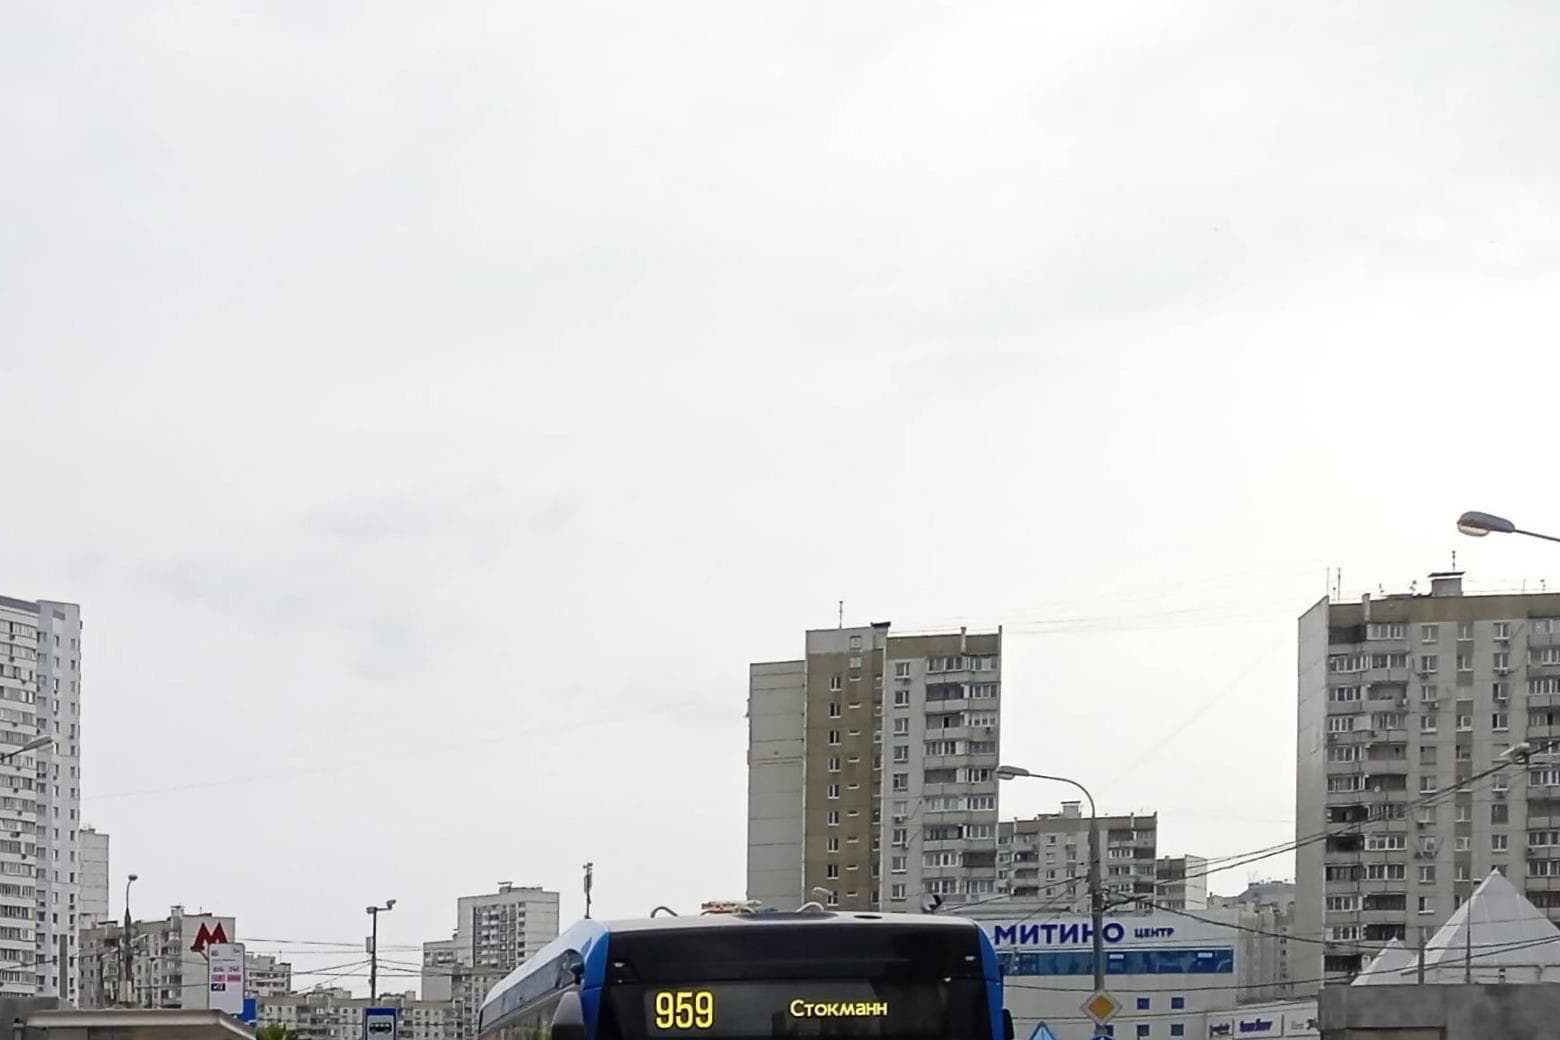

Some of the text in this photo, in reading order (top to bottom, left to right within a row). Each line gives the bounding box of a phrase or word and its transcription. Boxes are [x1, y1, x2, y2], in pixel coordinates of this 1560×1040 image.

[994, 922, 1175, 945] МИТИНО ЦЕНТР
[655, 991, 888, 1029] 959 Стокманн
